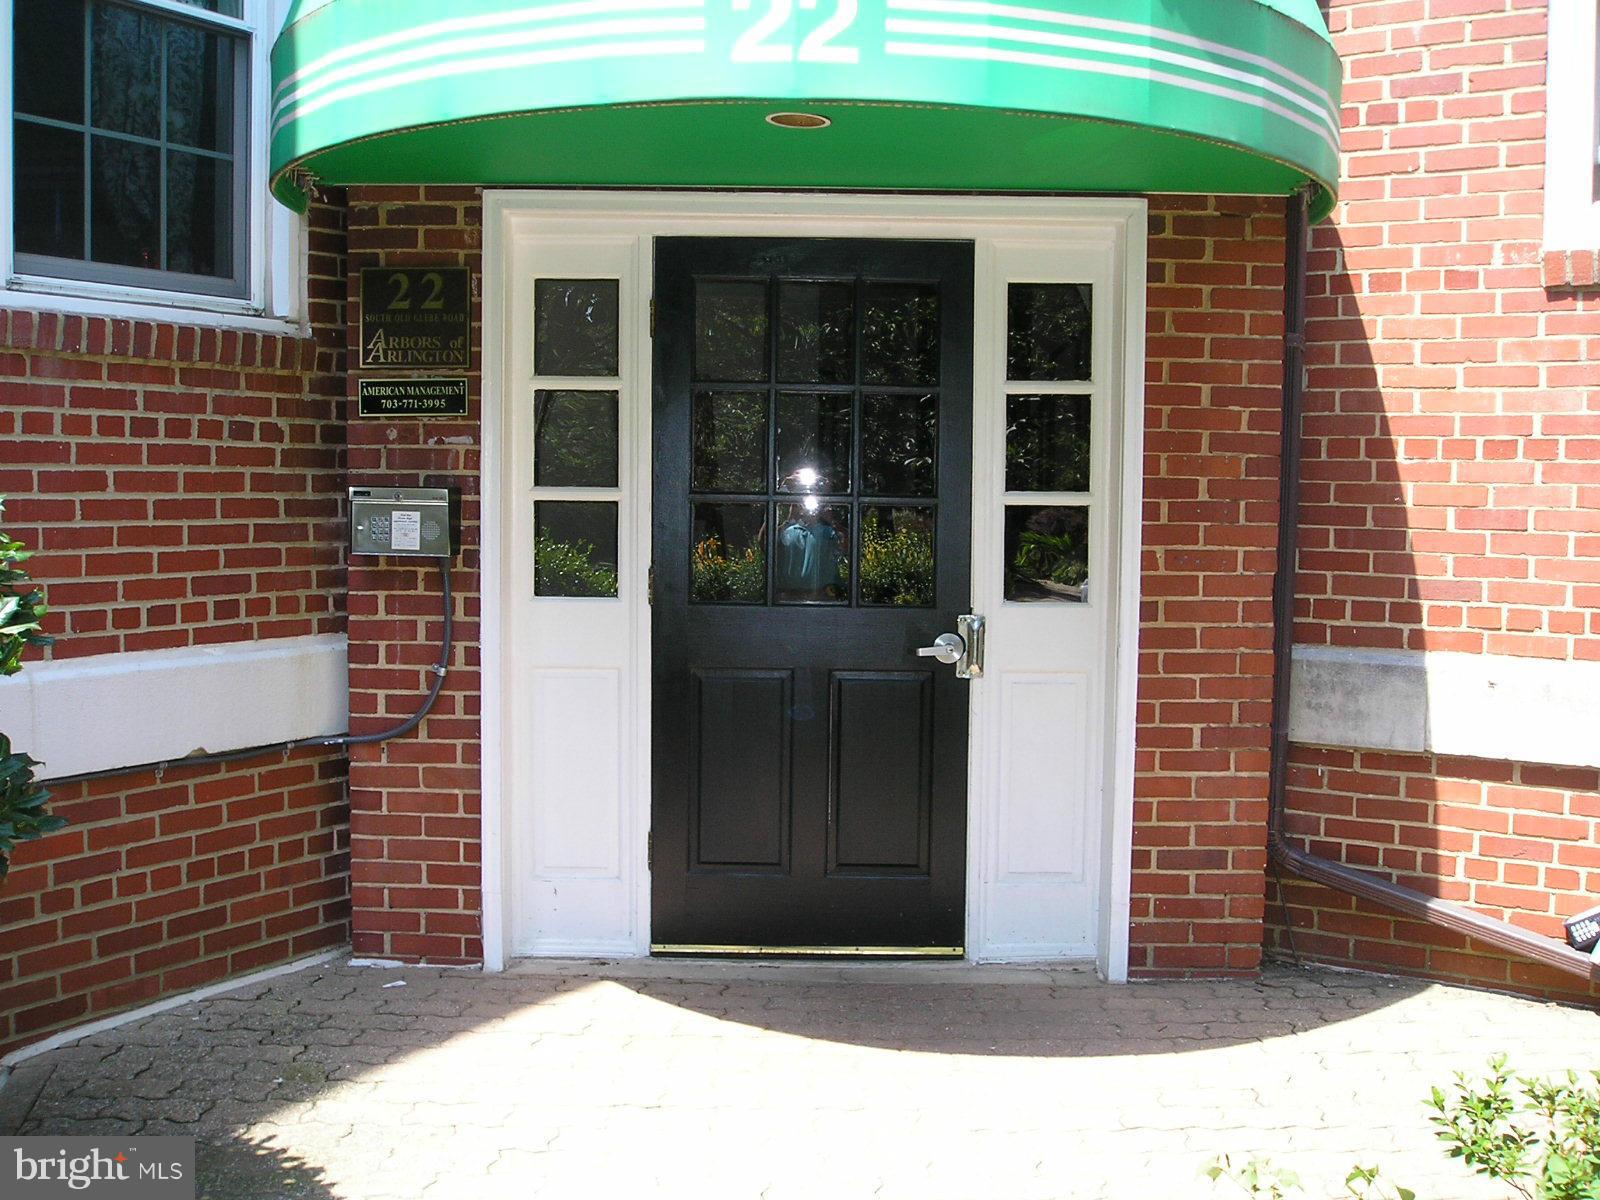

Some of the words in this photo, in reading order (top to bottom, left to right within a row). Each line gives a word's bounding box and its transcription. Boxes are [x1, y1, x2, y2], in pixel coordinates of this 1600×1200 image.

[732, 0, 859, 64] 22
[387, 272, 445, 309] 22
[366, 328, 441, 349] ARBORS
[449, 336, 464, 349] of
[365, 342, 464, 362] ARLINGTON
[362, 386, 405, 396] AMERICAN
[406, 386, 465, 395] MANAGEMENT
[381, 399, 446, 408] 703-771-3995
